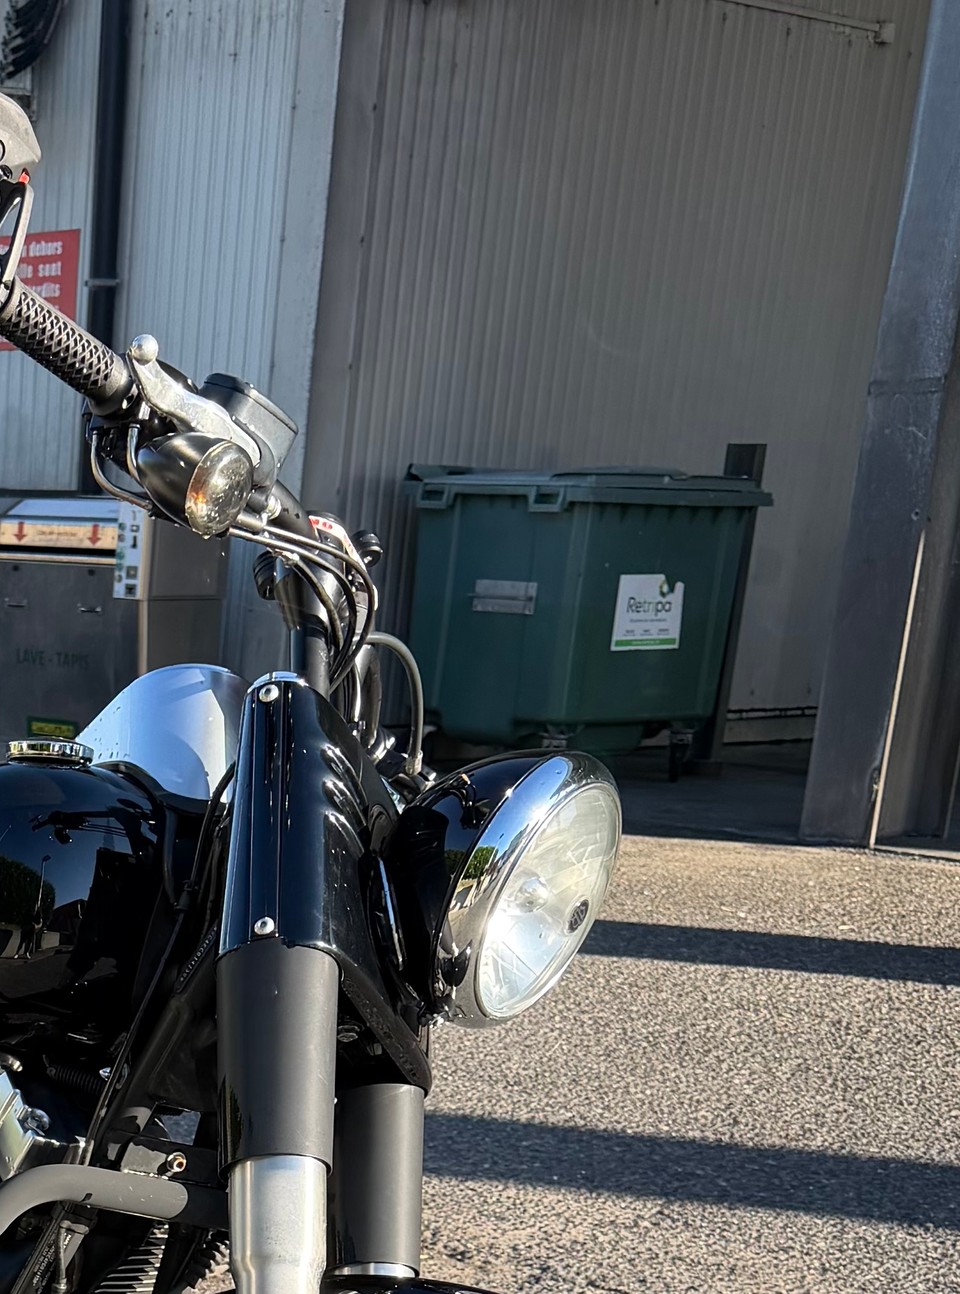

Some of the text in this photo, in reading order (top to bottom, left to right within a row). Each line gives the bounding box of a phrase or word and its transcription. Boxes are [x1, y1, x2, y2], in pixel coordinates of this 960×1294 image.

[626, 596, 672, 617] Retripa
[16, 648, 45, 666] LAVE
[56, 652, 91, 670] TAPIS
